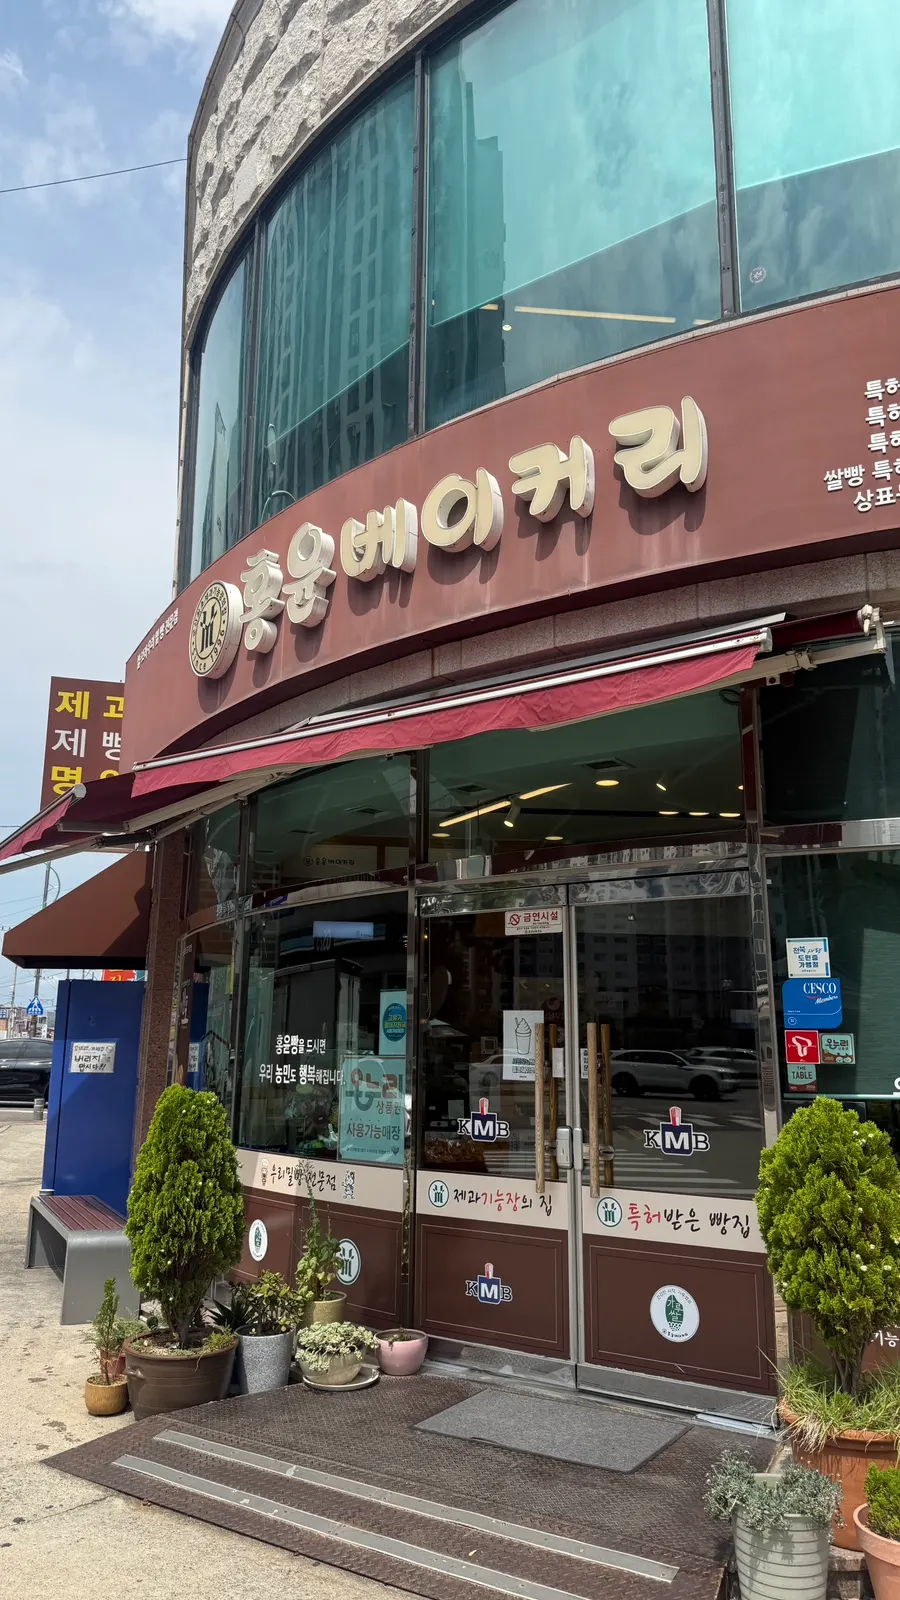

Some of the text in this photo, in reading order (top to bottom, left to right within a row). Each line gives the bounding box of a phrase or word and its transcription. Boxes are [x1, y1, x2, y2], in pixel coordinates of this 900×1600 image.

[823, 464, 865, 491] 쌀빵
[853, 484, 900, 512] 상표
[240, 396, 709, 653] 홍윤베이커리
[523, 911, 558, 922] 금연시설
[792, 945, 806, 955] 전북
[798, 954, 819, 962] 도민증
[798, 961, 819, 969] 가맹점
[803, 982, 837, 995] CESCO
[275, 1034, 327, 1055] 홍윤빵을 드시면
[74, 1054, 101, 1063] 버리지
[259, 1063, 274, 1083] 우리
[275, 1063, 297, 1085] 농민도
[791, 1071, 813, 1080] TABLE
[345, 1068, 404, 1112] 온누리
[346, 1122, 400, 1141] 사용가능매장
[458, 1118, 510, 1140] KMB
[644, 1129, 710, 1152] KMB
[453, 1188, 552, 1217] 제과기능장의 집
[627, 1203, 750, 1239] 특허받은 빵집
[465, 1280, 513, 1302] KMB
